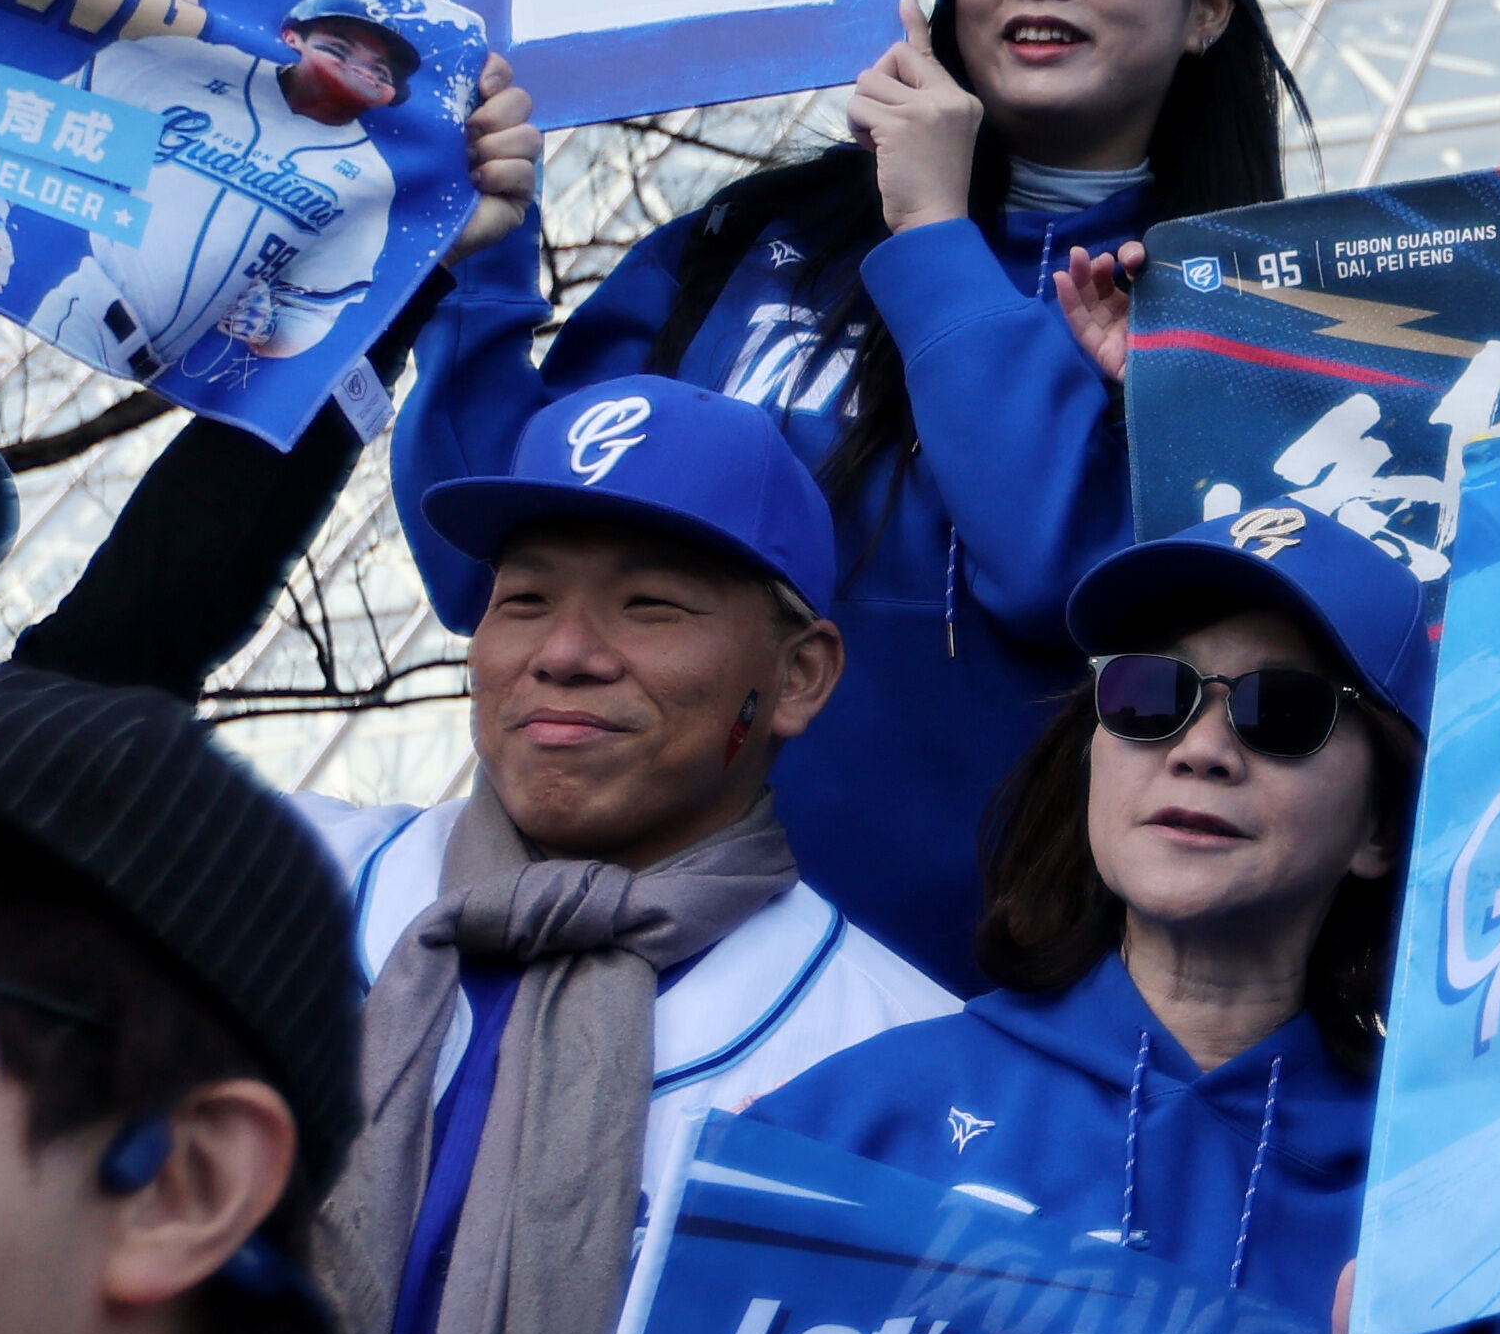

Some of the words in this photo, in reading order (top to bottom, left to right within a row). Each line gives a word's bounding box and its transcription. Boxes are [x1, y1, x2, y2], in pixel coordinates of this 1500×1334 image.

[154, 105, 345, 231] Guardians
[1335, 237, 1392, 258] FUBON
[1396, 225, 1498, 251] GUARDIANS
[1258, 250, 1303, 290] 95
[1337, 259, 1372, 279] DAI,
[1377, 254, 1404, 273] PEI
[1408, 247, 1454, 269] FENG
